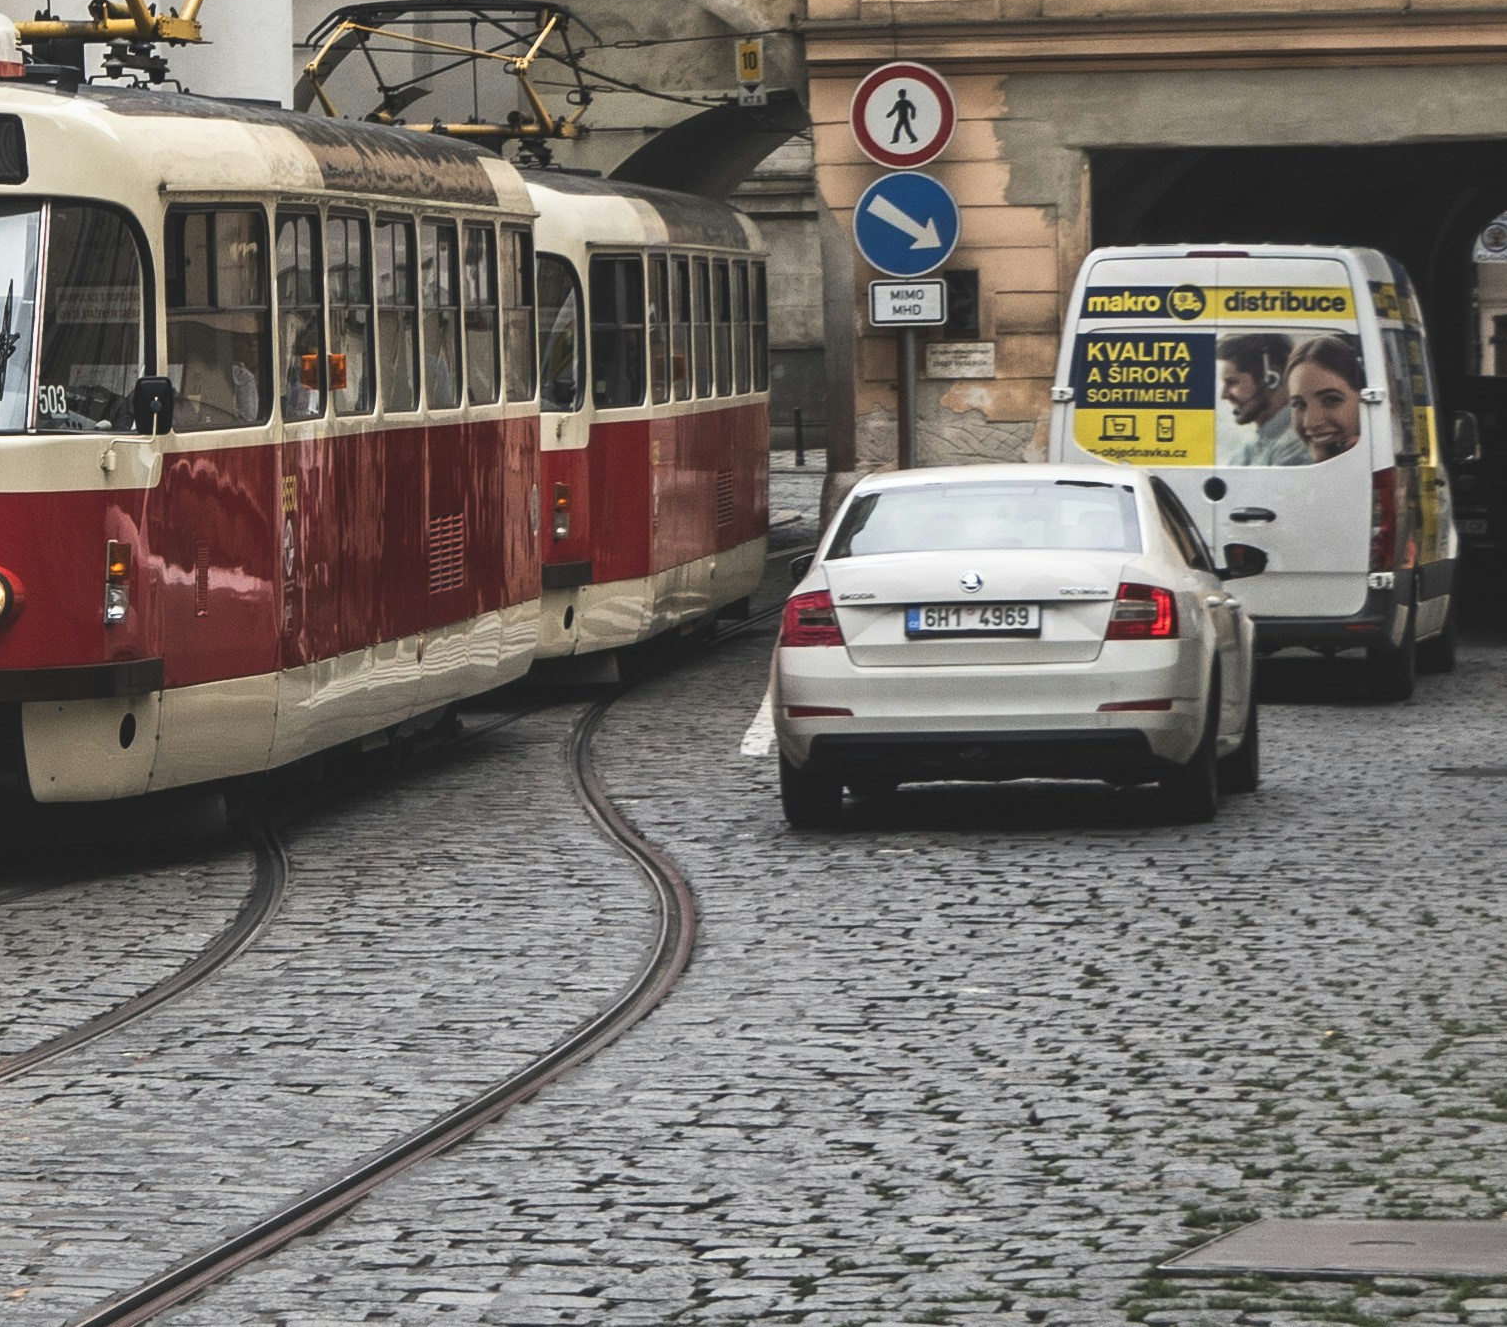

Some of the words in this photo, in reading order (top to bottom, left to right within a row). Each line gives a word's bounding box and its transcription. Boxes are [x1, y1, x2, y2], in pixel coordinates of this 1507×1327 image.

[741, 51, 758, 70] 10
[890, 289, 925, 301] MIMO
[1087, 291, 1161, 312] makro
[1224, 291, 1346, 312] distribuce
[892, 305, 922, 316] MHD
[1087, 342, 1191, 362] KVALITA
[1087, 367, 1102, 383] A
[1108, 362, 1191, 383] ŠIROKÝ
[39, 385, 67, 414] 503
[1086, 388, 1191, 402] SORTIMENT
[924, 607, 962, 627] 6H1
[979, 607, 1030, 627] 4969
